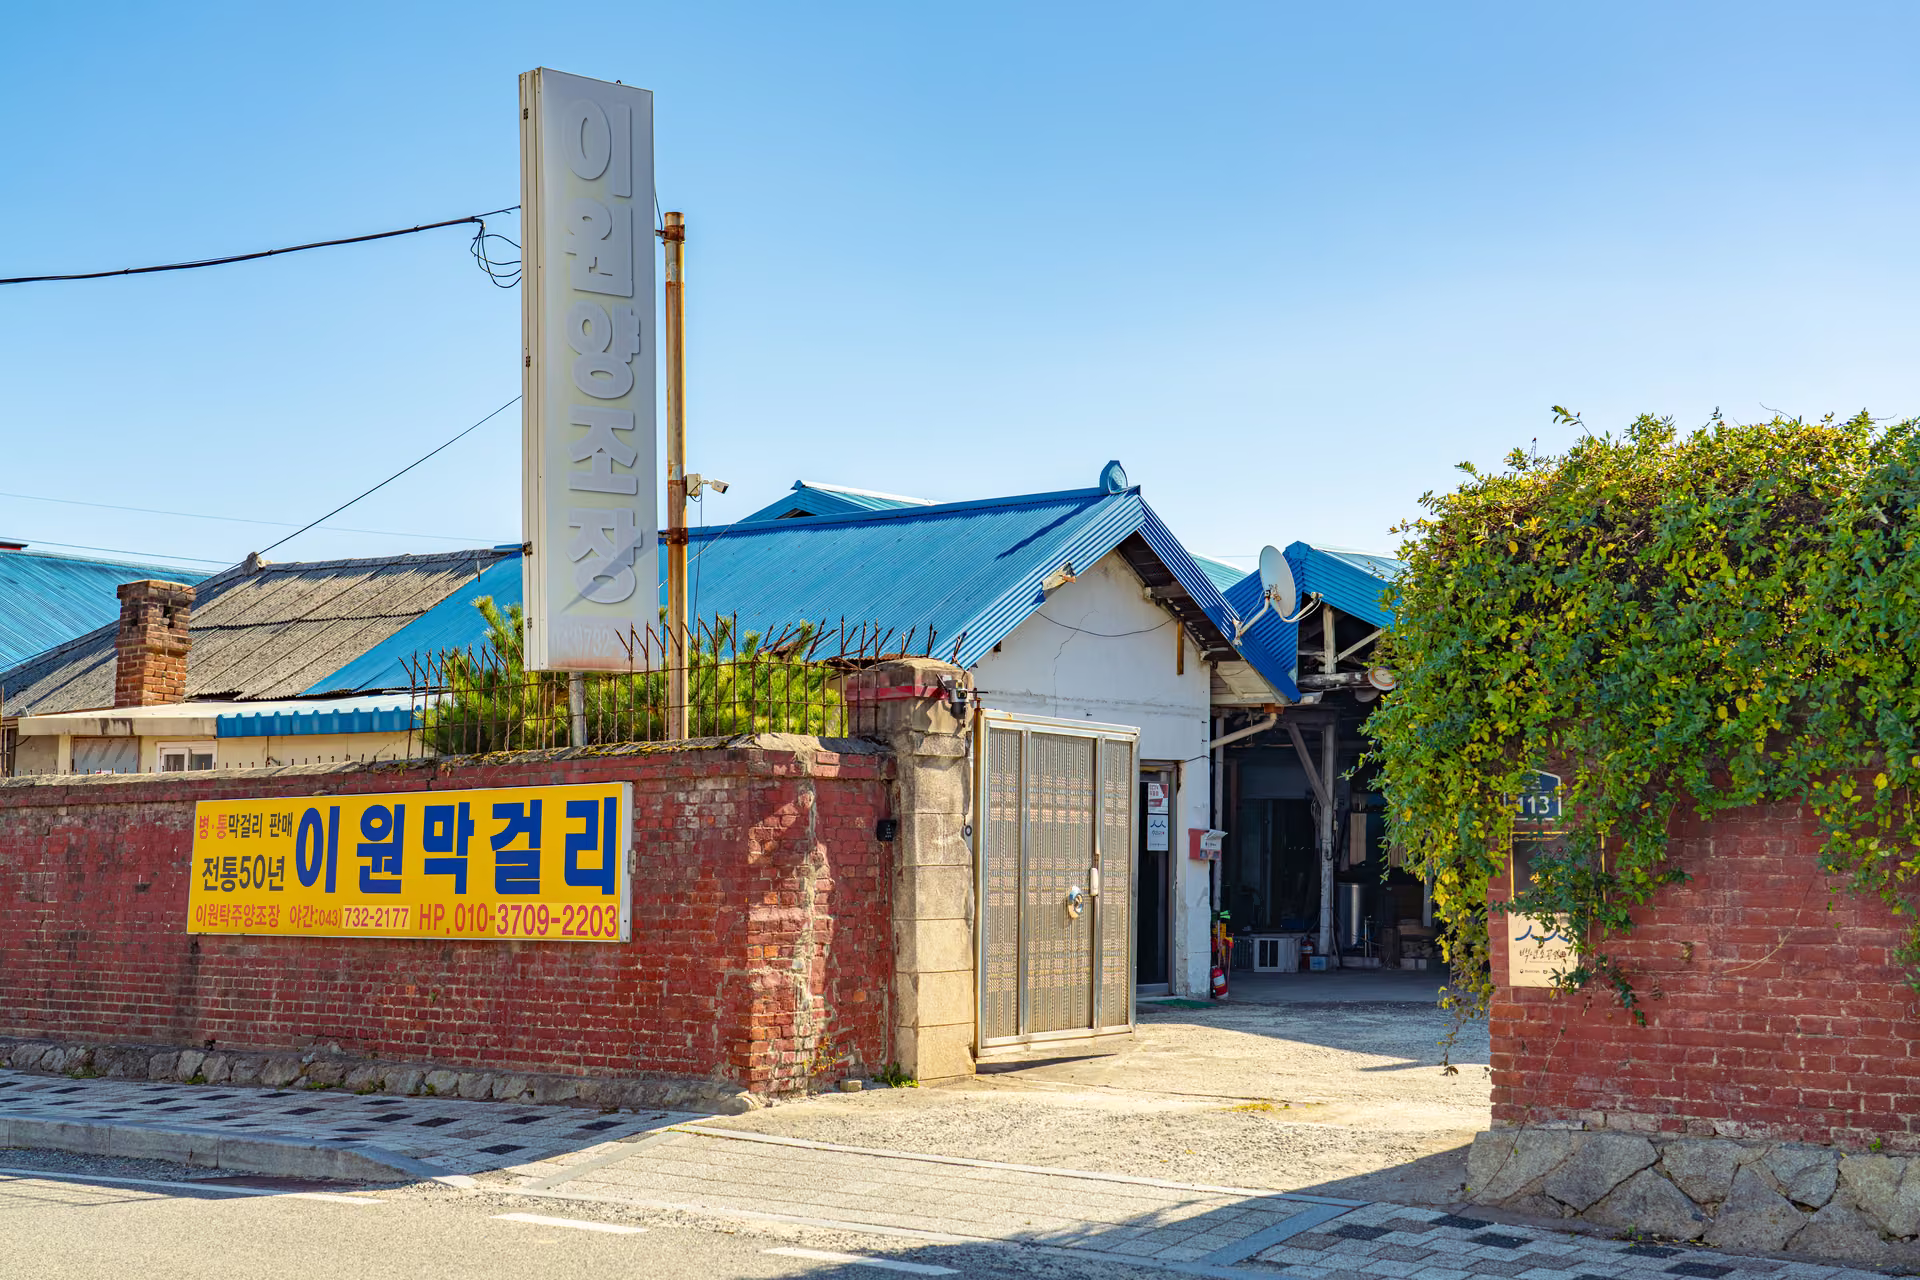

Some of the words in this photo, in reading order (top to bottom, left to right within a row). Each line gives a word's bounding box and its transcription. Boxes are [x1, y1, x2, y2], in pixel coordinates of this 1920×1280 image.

[562, 100, 642, 605] 이원양조장
[1516, 796, 1550, 814] 113
[269, 811, 294, 838] 판매
[295, 797, 618, 895] 이원막걸리
[202, 854, 285, 892] 전통50년
[195, 903, 281, 928] 이원탁주양조장
